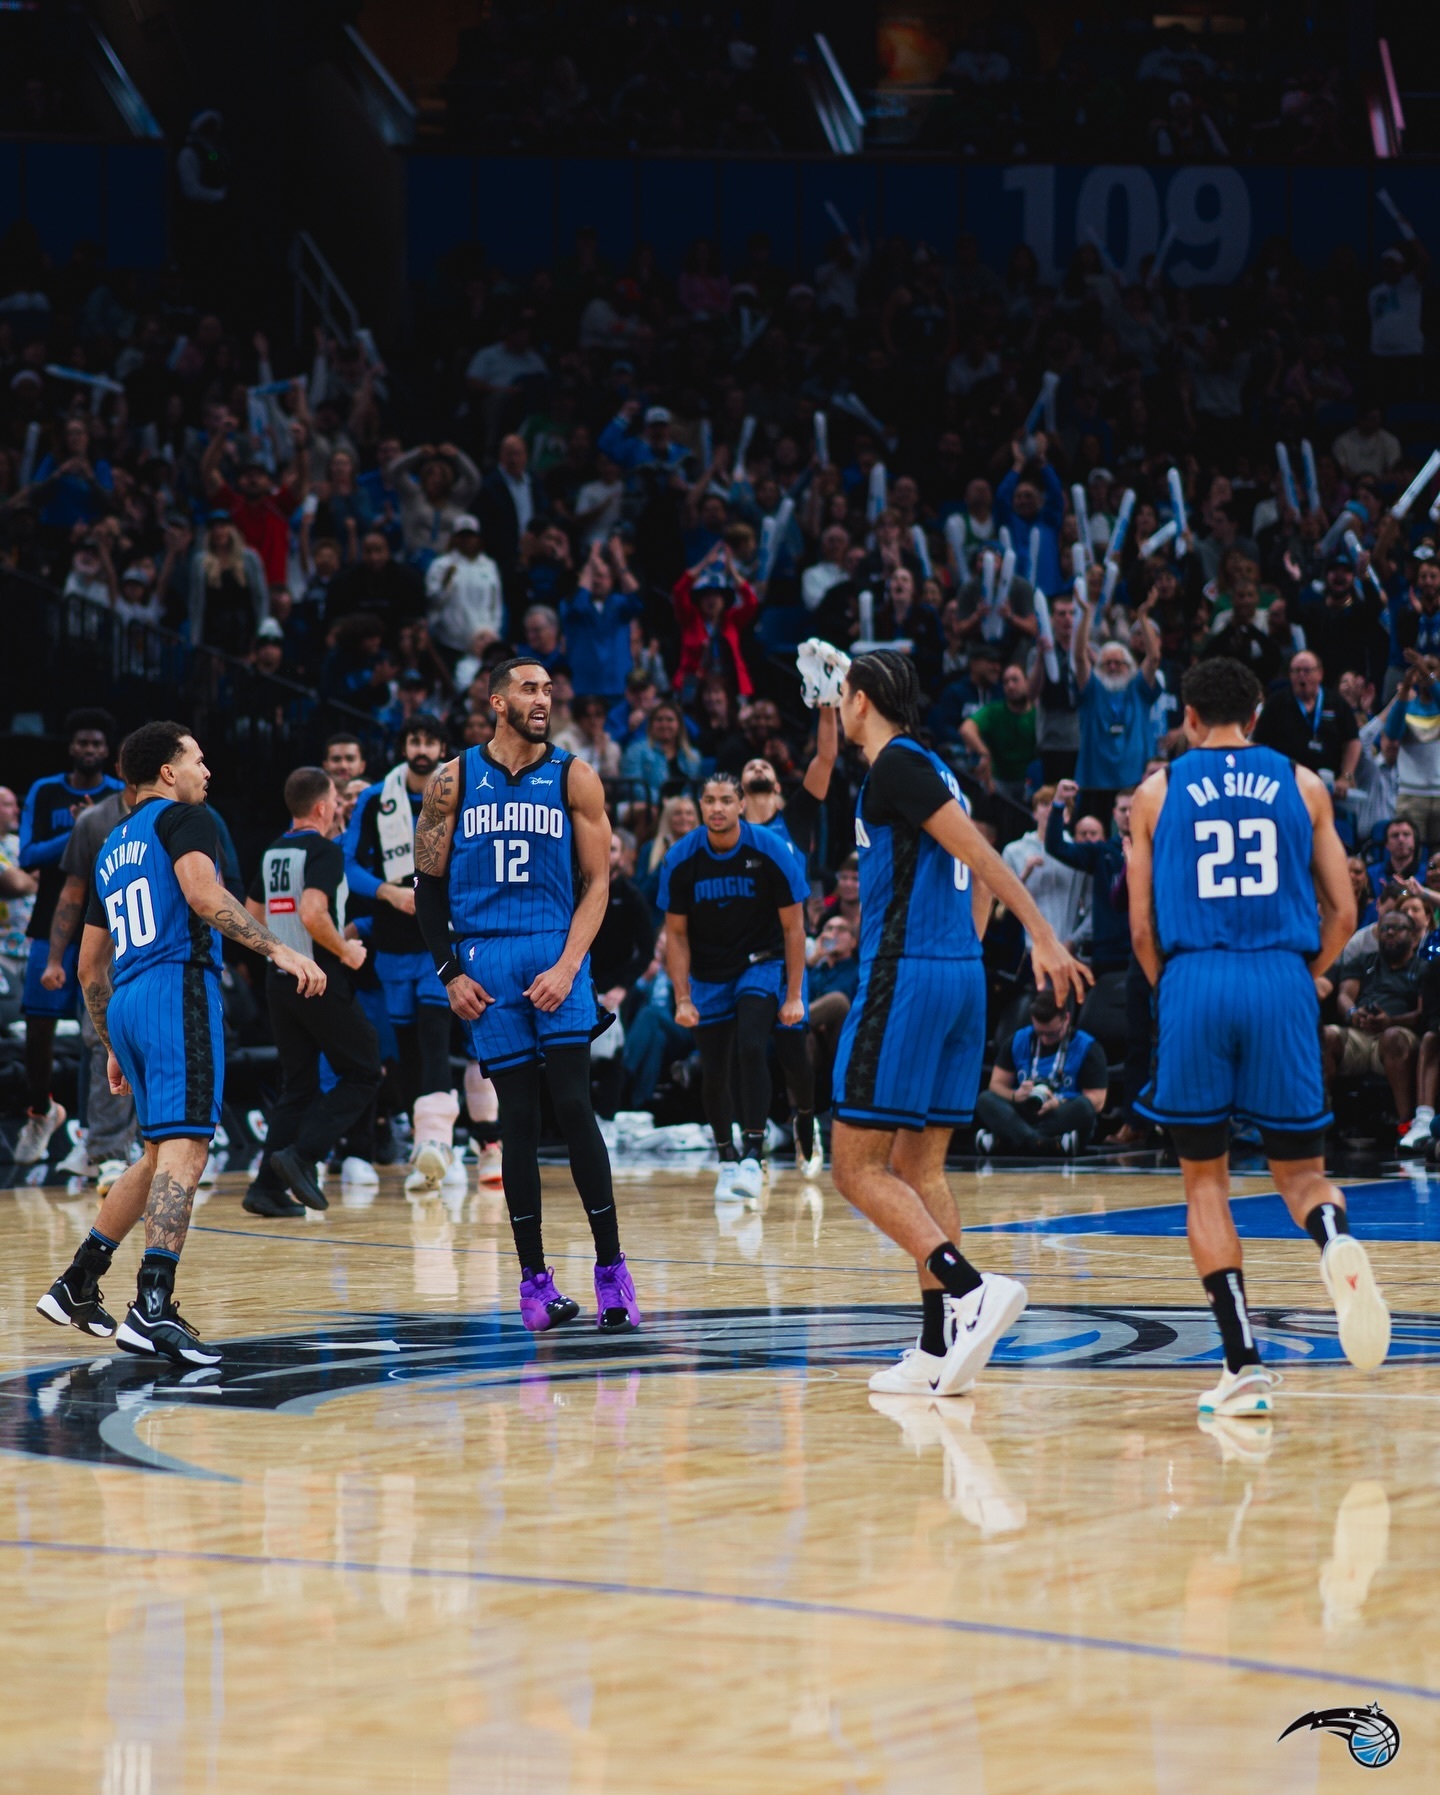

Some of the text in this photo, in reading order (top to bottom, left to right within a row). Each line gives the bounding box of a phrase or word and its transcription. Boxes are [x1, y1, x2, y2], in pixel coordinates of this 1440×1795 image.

[1002, 164, 1252, 288] 109
[528, 776, 554, 786] Disney
[1186, 771, 1281, 808] DA SILVA
[463, 801, 564, 839] ORLANDO
[99, 840, 148, 887] ANTHONY
[269, 857, 291, 893] 36
[493, 839, 530, 883] 12
[1194, 817, 1279, 899] 23
[694, 875, 757, 903] MAGIC
[104, 876, 157, 962] 50
